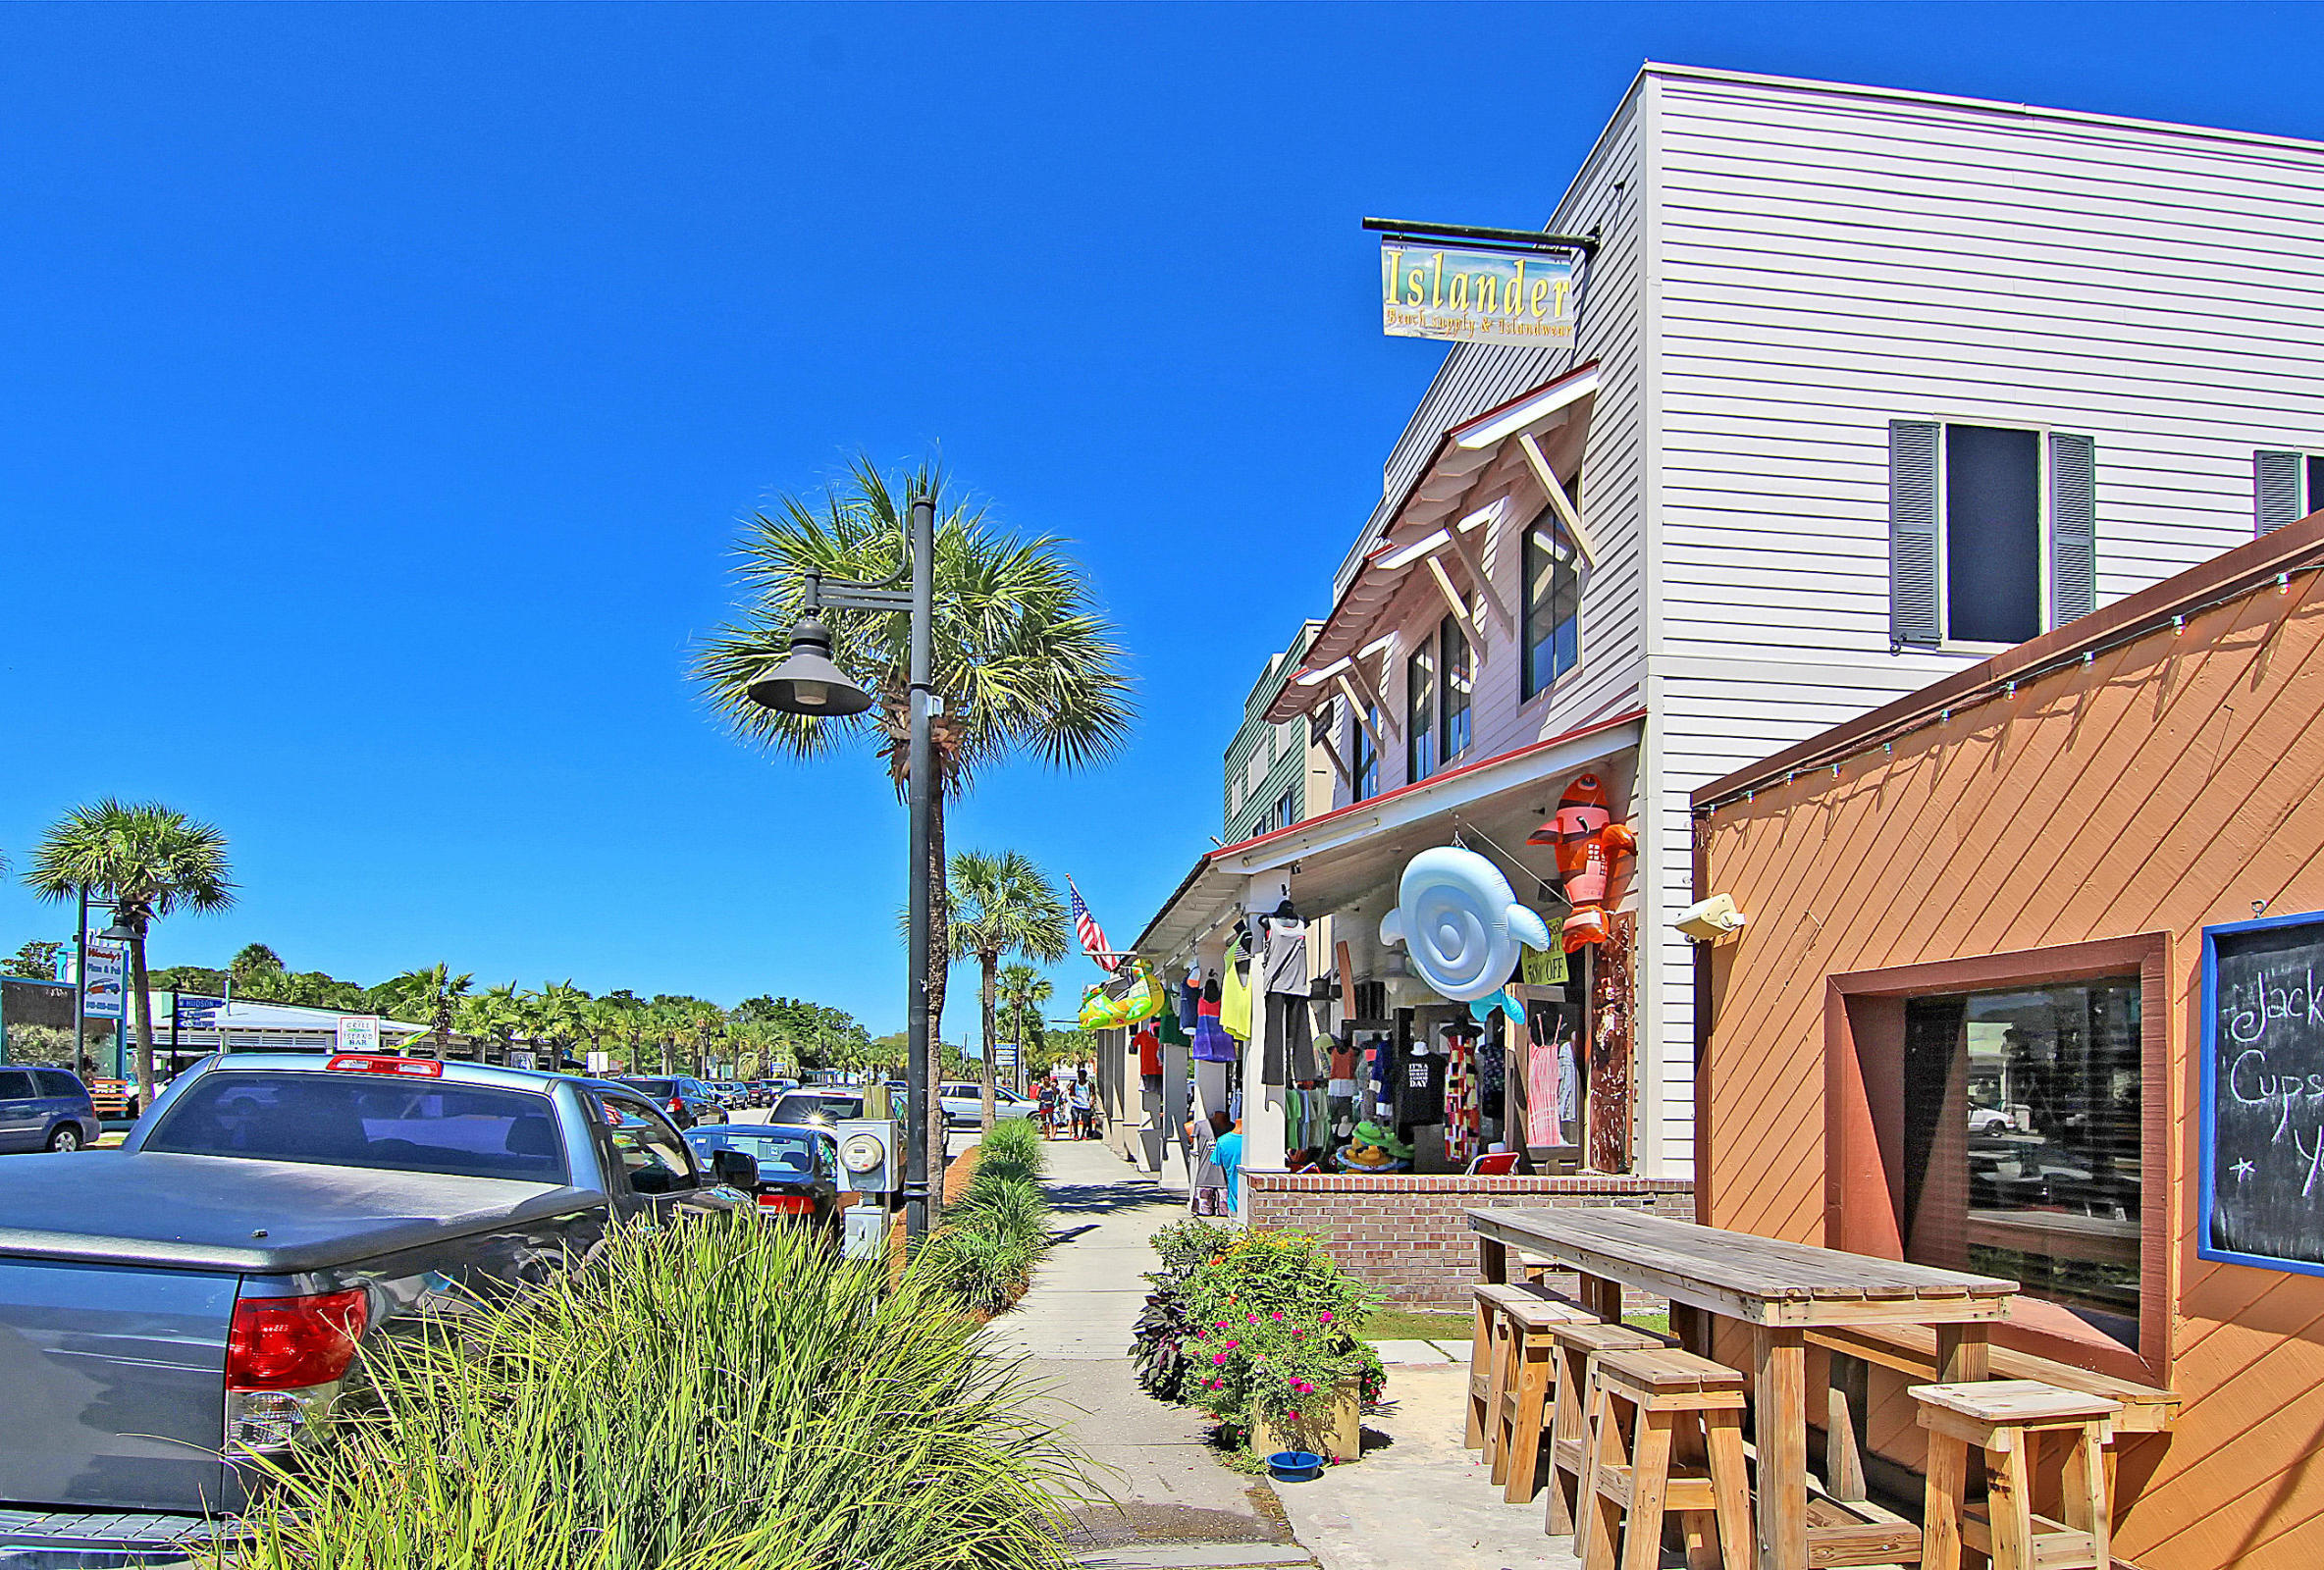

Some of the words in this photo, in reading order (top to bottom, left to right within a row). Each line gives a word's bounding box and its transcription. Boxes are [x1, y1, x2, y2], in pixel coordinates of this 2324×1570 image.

[1385, 249, 1571, 318] Islander
[1387, 307, 1426, 328] Beach
[1480, 317, 1494, 334] &
[1498, 315, 1573, 339] Islandwear
[87, 947, 122, 964] Woody's
[1546, 957, 1563, 981] OFF
[186, 999, 214, 1008] HUDSON
[2231, 1049, 2324, 1142] Cups
